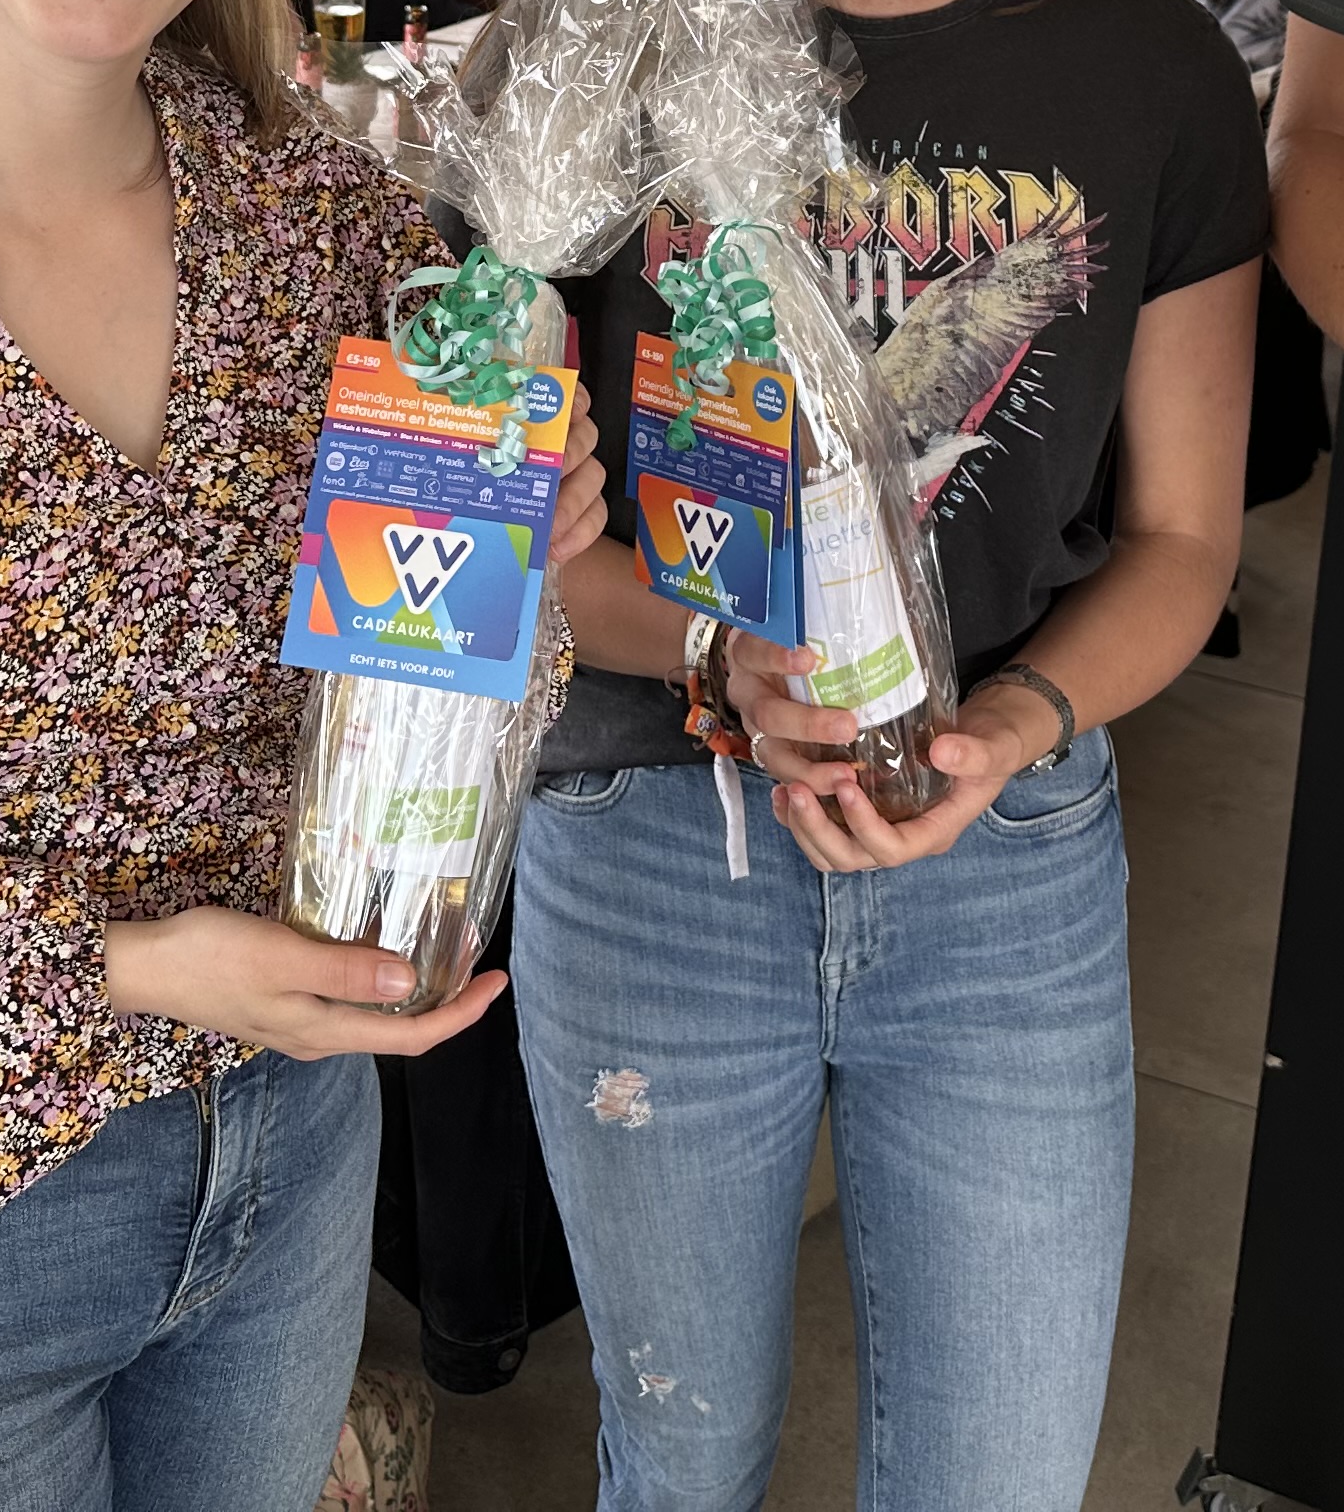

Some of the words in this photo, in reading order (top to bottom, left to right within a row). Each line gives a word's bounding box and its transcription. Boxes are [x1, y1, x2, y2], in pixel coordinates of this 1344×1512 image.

[848, 139, 988, 161] ERICAN
[346, 353, 381, 368] €5-150
[525, 391, 548, 402] okaal
[548, 394, 558, 403] te
[532, 382, 550, 392] Ook
[638, 377, 674, 399] Oneindig
[696, 397, 740, 418] opmerken,
[338, 387, 393, 409] Oneindig
[395, 397, 421, 410] veel
[422, 399, 493, 423] topmerken,
[528, 402, 558, 413] steden
[637, 391, 684, 411] restaurants
[335, 402, 406, 423] restaurants
[408, 414, 425, 425] en
[427, 414, 504, 438] belevenisse
[435, 455, 465, 468] Praxis
[660, 571, 741, 607] CADEAUKAART
[352, 615, 475, 646] CADEAUKAART
[349, 653, 375, 667] ECHT
[377, 658, 398, 670] IETS
[400, 661, 429, 675] VOOR
[430, 666, 455, 680] JOU!
